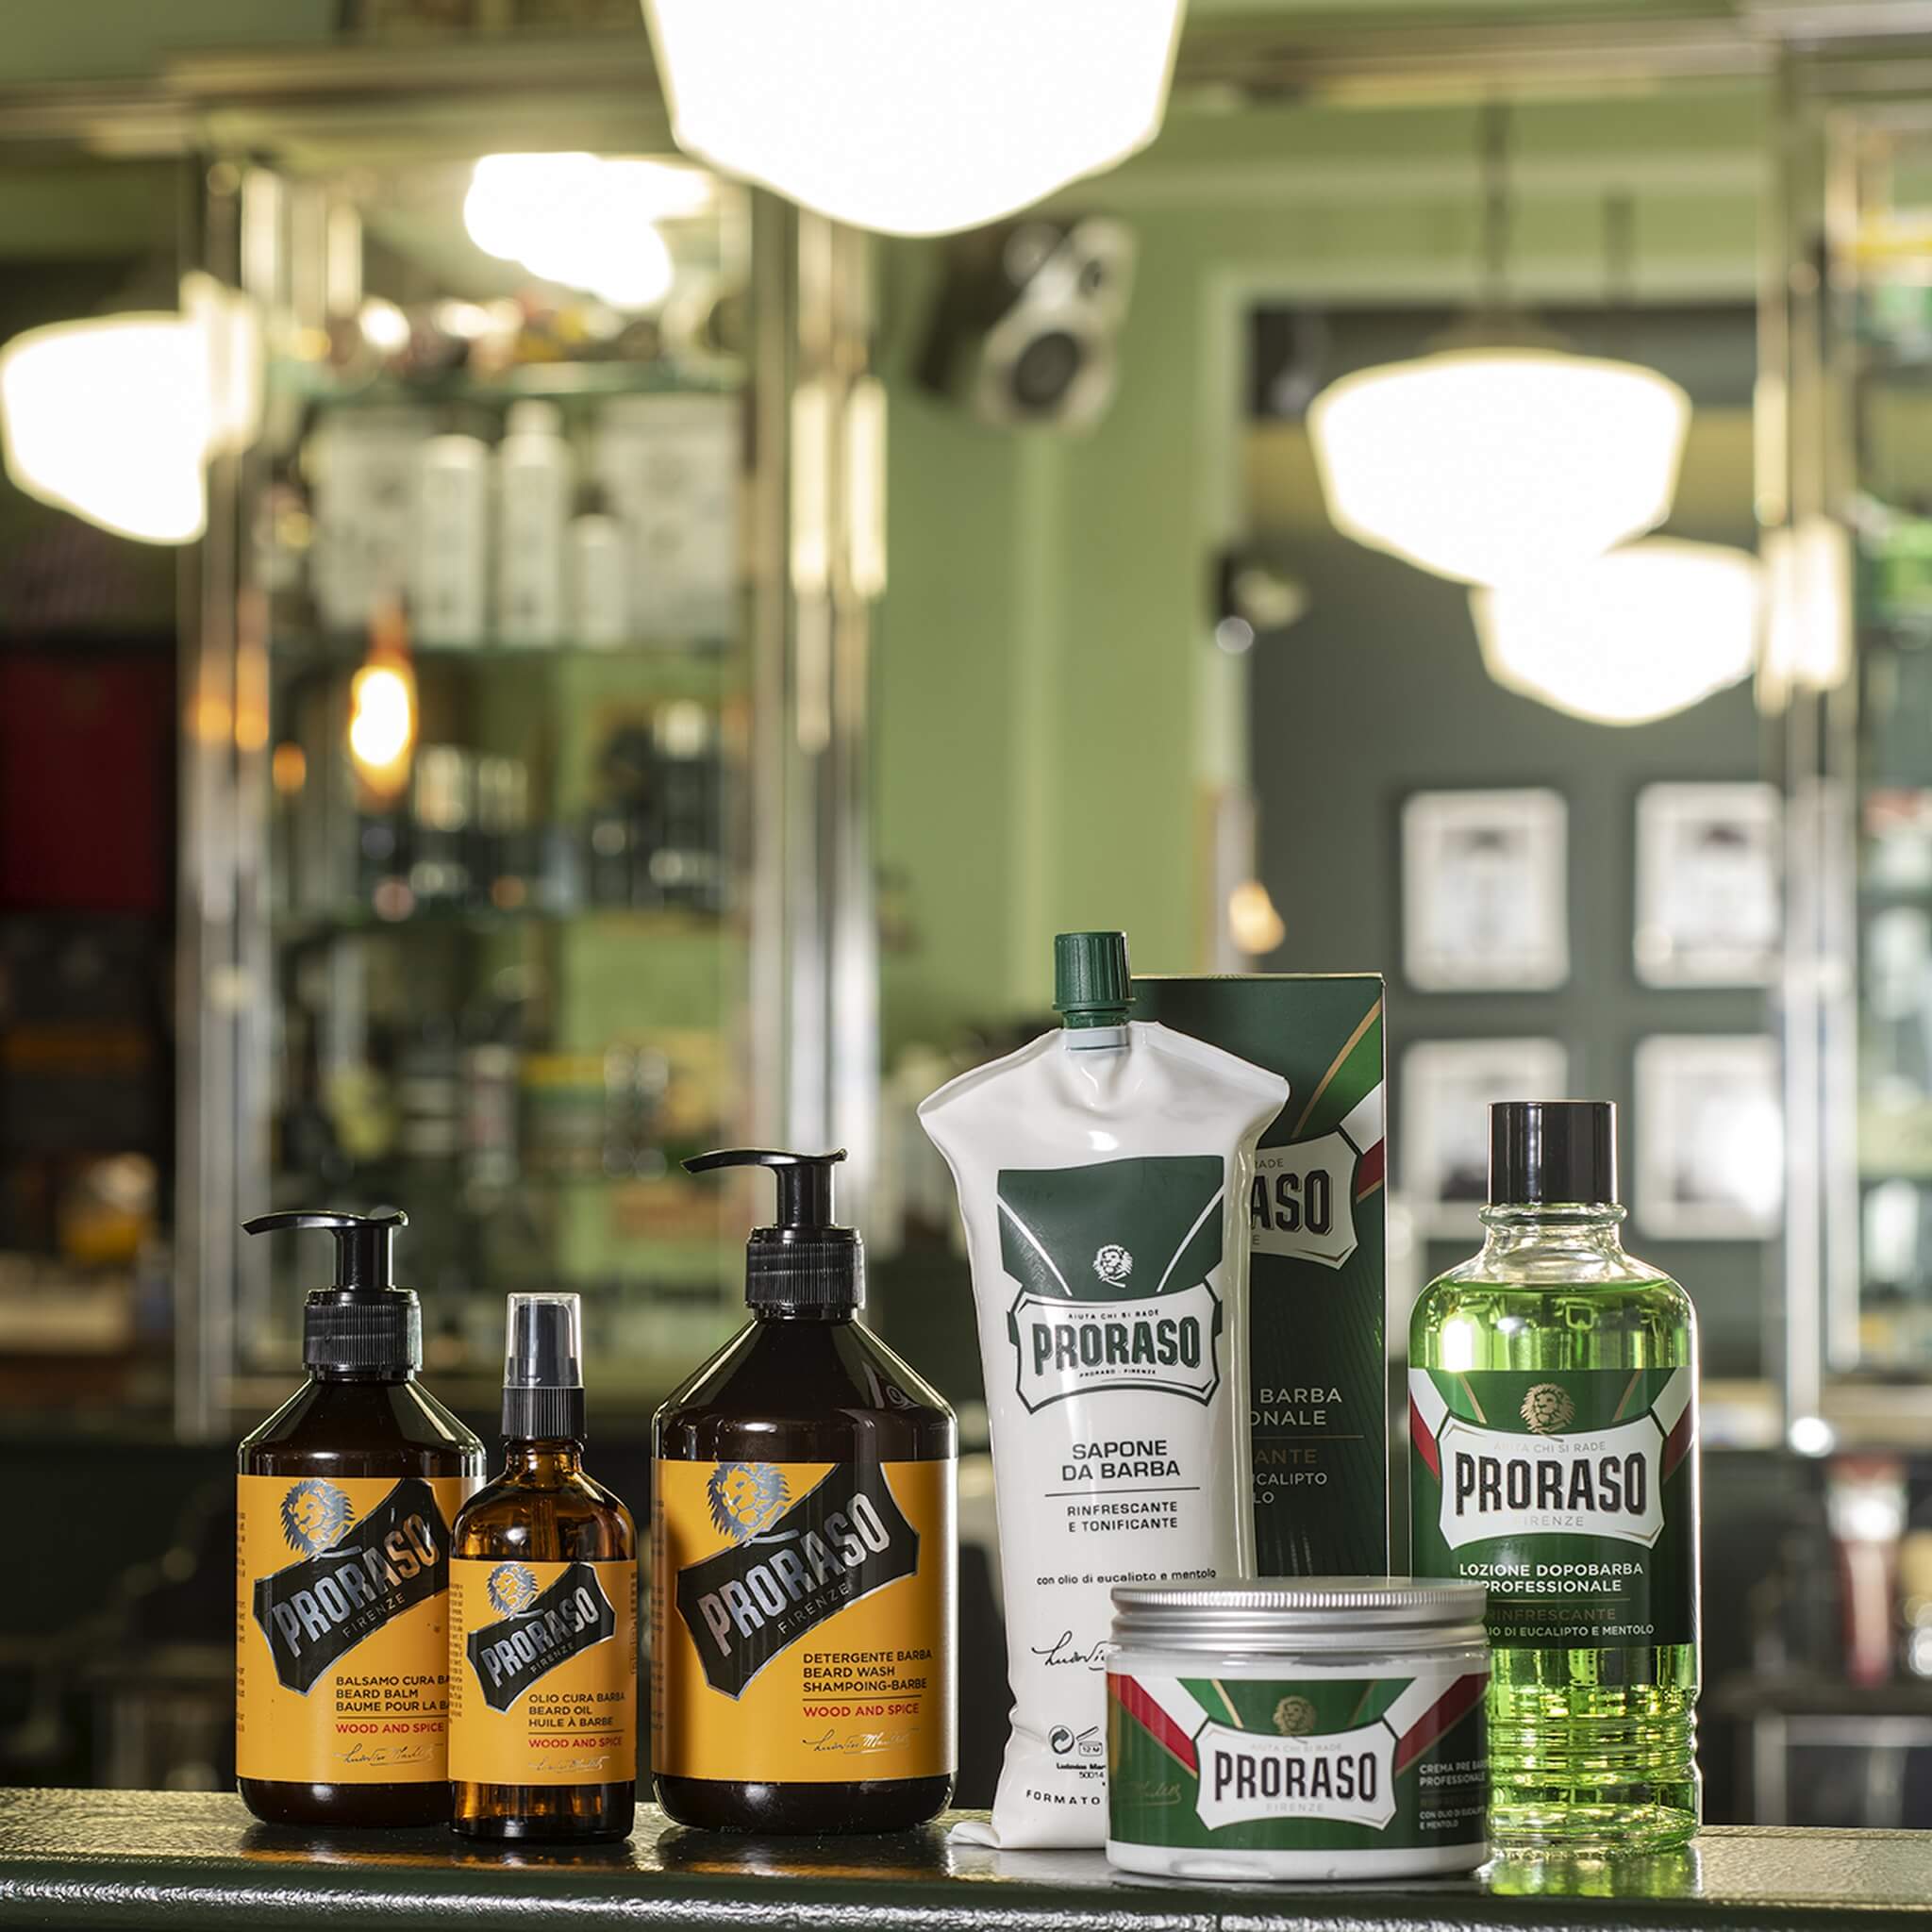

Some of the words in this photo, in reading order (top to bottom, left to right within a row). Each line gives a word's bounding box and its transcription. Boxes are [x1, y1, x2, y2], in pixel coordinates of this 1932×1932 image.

[1032, 1316, 1201, 1376] PRORASO
[1260, 1388, 1342, 1404] BARBA
[1073, 1440, 1168, 1460] SAPONE
[1533, 1443, 1555, 1454] CHI
[1558, 1443, 1570, 1454] SI
[1574, 1441, 1606, 1453] RADE
[1062, 1464, 1092, 1481] DA
[1101, 1460, 1181, 1479] BARBA
[1253, 1473, 1328, 1485] CALIPTO
[1455, 1451, 1647, 1517] PRORASO
[1067, 1502, 1178, 1516] RINFRESCANTE
[1069, 1522, 1075, 1532] E
[1082, 1518, 1178, 1532] TONIFICANTE
[1521, 1516, 1585, 1527] IRENZE
[697, 1492, 891, 1657] PRORASO
[1459, 1564, 1531, 1577] LOZIONE
[1537, 1562, 1644, 1577] DOPOBARBA
[1037, 1576, 1055, 1586] con
[1058, 1574, 1078, 1585] olio
[1082, 1574, 1093, 1584] di
[1171, 1568, 1217, 1580] mentolo
[271, 1513, 441, 1658] PRORASO
[1485, 1580, 1622, 1593] PROFESSIONALE
[776, 1579, 854, 1635] FIRENZE
[341, 1592, 406, 1638] FIRENZE
[480, 1586, 599, 1688] PRORASO
[1505, 1626, 1517, 1637] DI
[1520, 1625, 1589, 1637] EUCALIPTO
[1592, 1625, 1600, 1637] E
[1602, 1624, 1655, 1636] MENTOLO
[529, 1642, 575, 1674] FIRENZE
[804, 1651, 893, 1663] DETERGENTE
[897, 1649, 932, 1662] BARBA
[804, 1667, 853, 1678] BEARD
[858, 1666, 895, 1677] WASH
[336, 1676, 399, 1686] BALSAMO
[402, 1675, 435, 1686] CURA
[803, 1677, 927, 1692] SHAMPOING-BARBE
[336, 1689, 380, 1699] BEARD
[384, 1689, 419, 1698] BALM
[529, 1694, 558, 1703] OLIO
[562, 1693, 594, 1703] CURA
[336, 1702, 381, 1711] BAUME
[385, 1701, 419, 1711] POUR
[423, 1701, 438, 1710] LA
[529, 1706, 571, 1715] BEARD
[574, 1706, 592, 1714] OIL
[803, 1706, 851, 1717] WOOD
[856, 1705, 885, 1716] AND
[888, 1703, 920, 1715] SPICE
[336, 1724, 378, 1733] WOOD
[382, 1724, 409, 1733] AND
[413, 1723, 444, 1733] SPICE
[529, 1718, 564, 1727] HUILE
[567, 1716, 576, 1727] À
[528, 1739, 569, 1748] WOOD
[573, 1738, 597, 1747] AND
[1419, 1763, 1454, 1774] CREMA
[1215, 1750, 1377, 1802] PRORASO
[1026, 1789, 1101, 1806] FORMATO
[1266, 1802, 1324, 1812] FIRENZE
